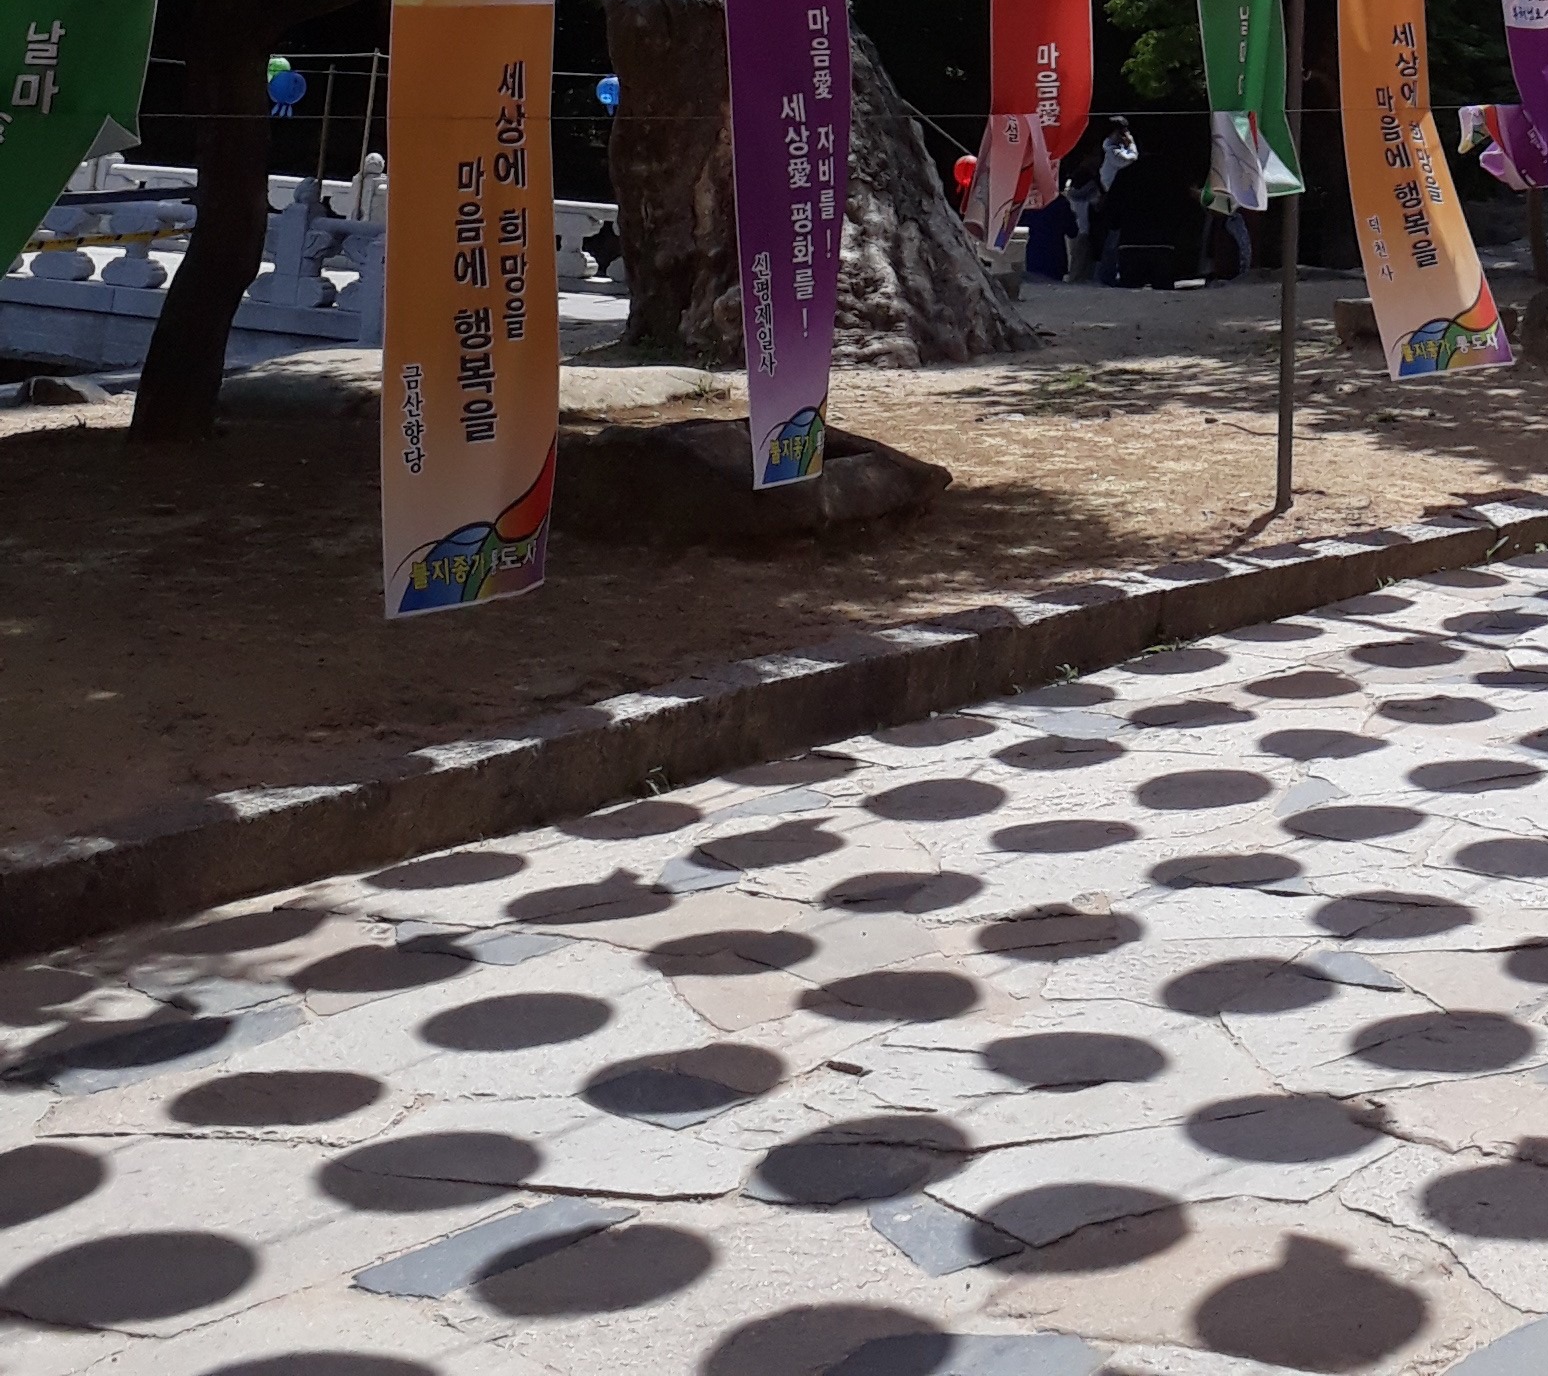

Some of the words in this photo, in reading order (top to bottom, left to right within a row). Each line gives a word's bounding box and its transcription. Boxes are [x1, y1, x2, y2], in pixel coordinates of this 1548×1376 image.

[493, 60, 528, 191] 세상에
[453, 156, 491, 289] 마음에
[496, 206, 528, 341] 희망을
[453, 307, 498, 444] 행복을
[751, 252, 777, 377] 신평제일사
[401, 363, 426, 474] 금산향당
